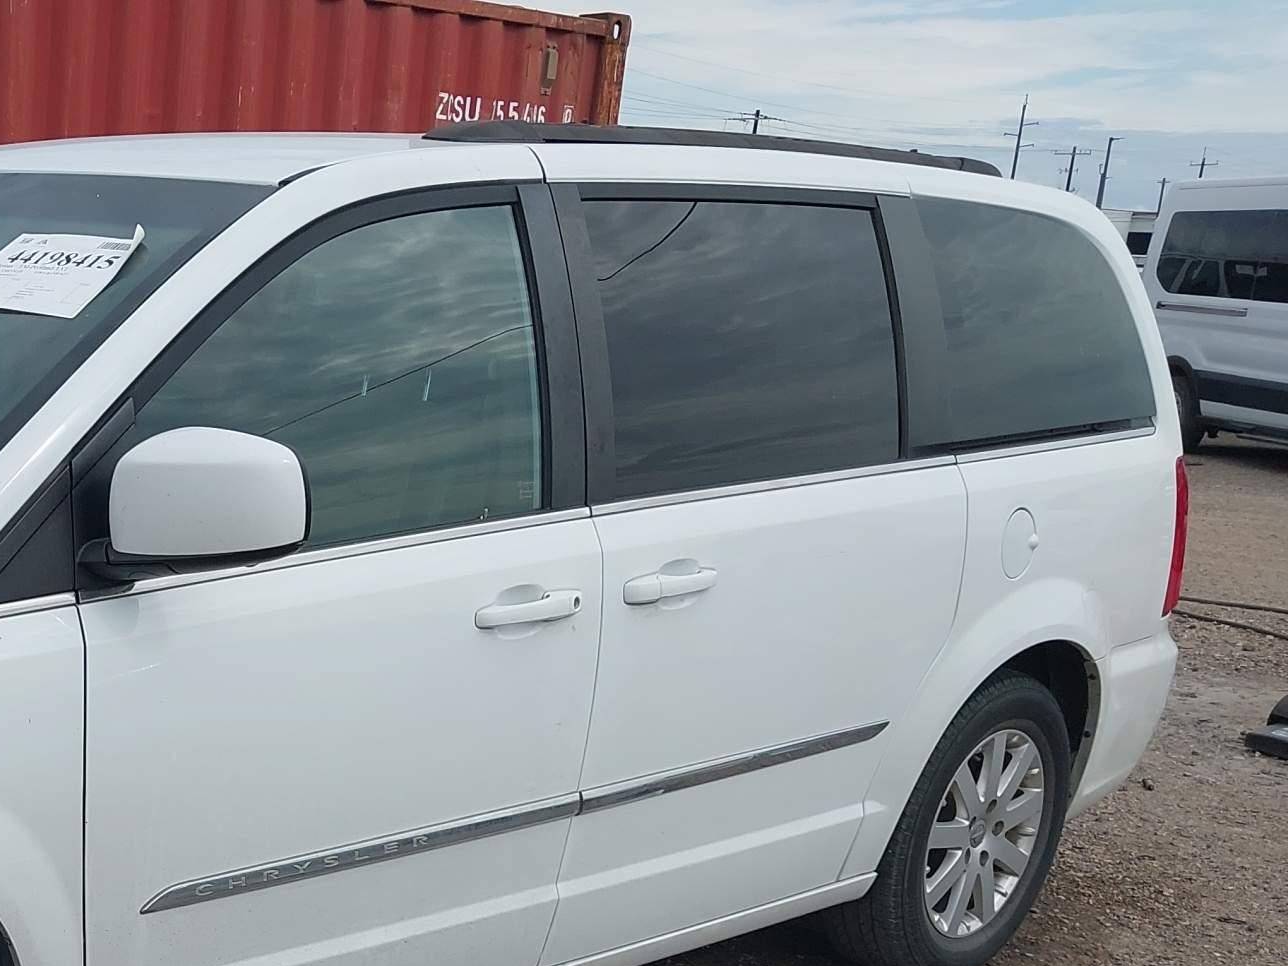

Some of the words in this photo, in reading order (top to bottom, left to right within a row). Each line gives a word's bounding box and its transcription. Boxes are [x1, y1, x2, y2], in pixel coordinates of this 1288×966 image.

[435, 92, 482, 123] ZCSU
[7, 249, 122, 269] 44198415
[195, 834, 431, 897] CHRYSLER
